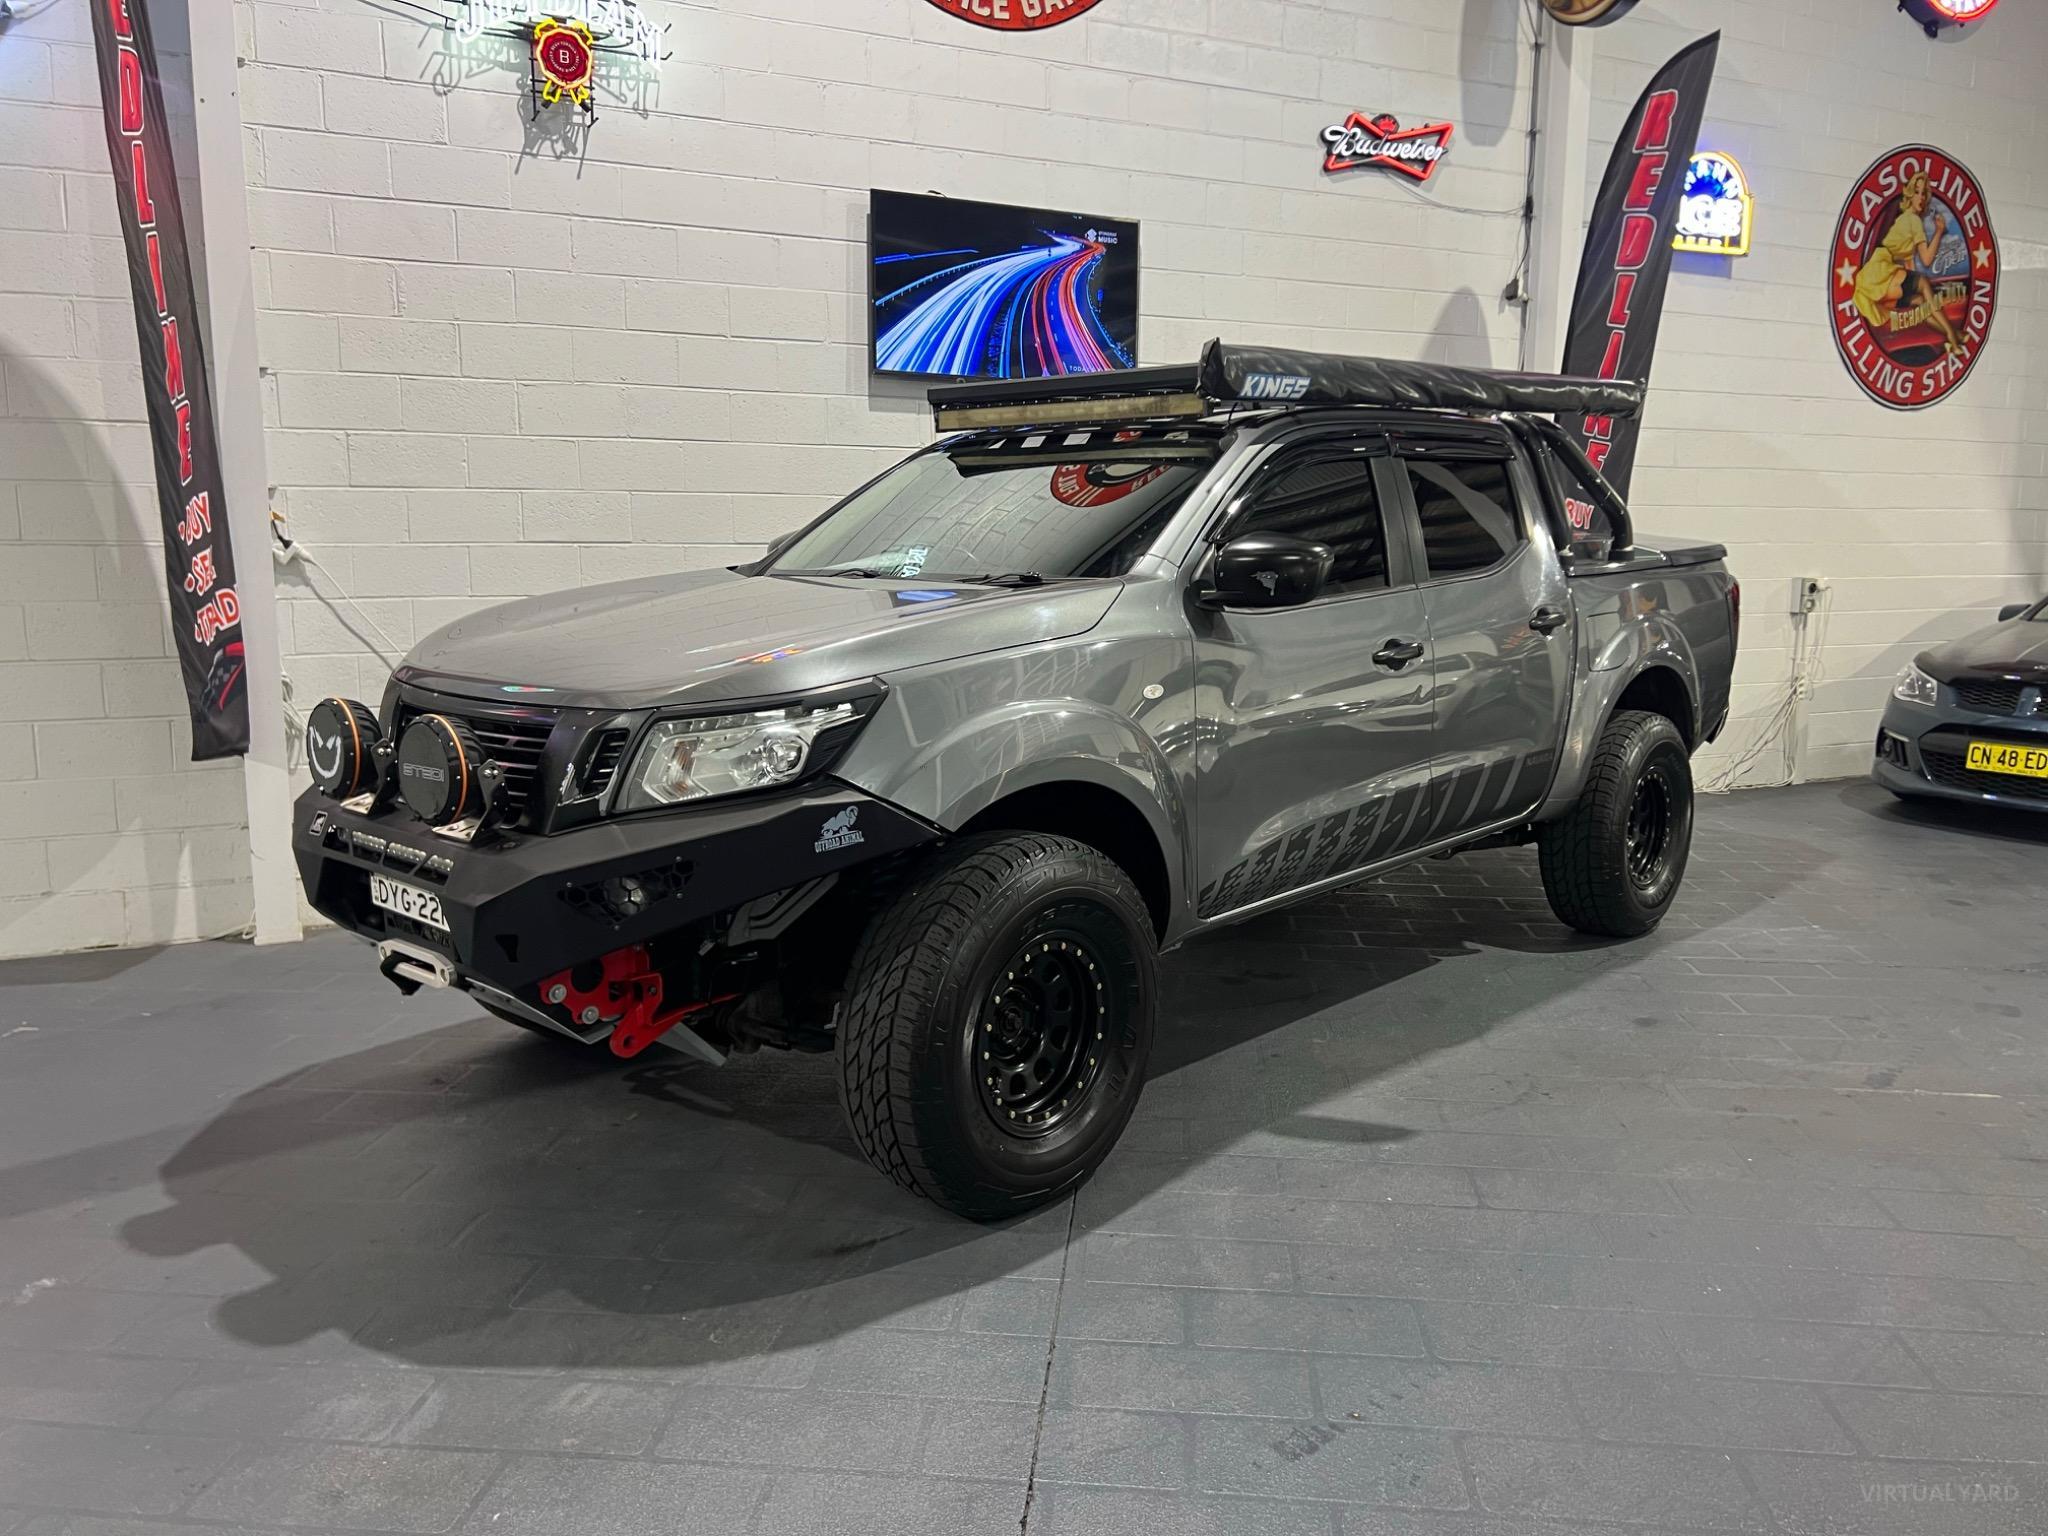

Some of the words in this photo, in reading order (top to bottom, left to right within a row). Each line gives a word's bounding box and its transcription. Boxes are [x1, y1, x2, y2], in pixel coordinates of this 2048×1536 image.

[560, 50, 570, 64] B
[1325, 125, 1444, 161] Budweiser
[1843, 156, 1985, 250] GASOLINE
[1098, 236, 1118, 244] MUSIC
[1837, 300, 1915, 399] FILLING
[1239, 375, 1311, 399] KINGS
[403, 763, 445, 782] STEDI
